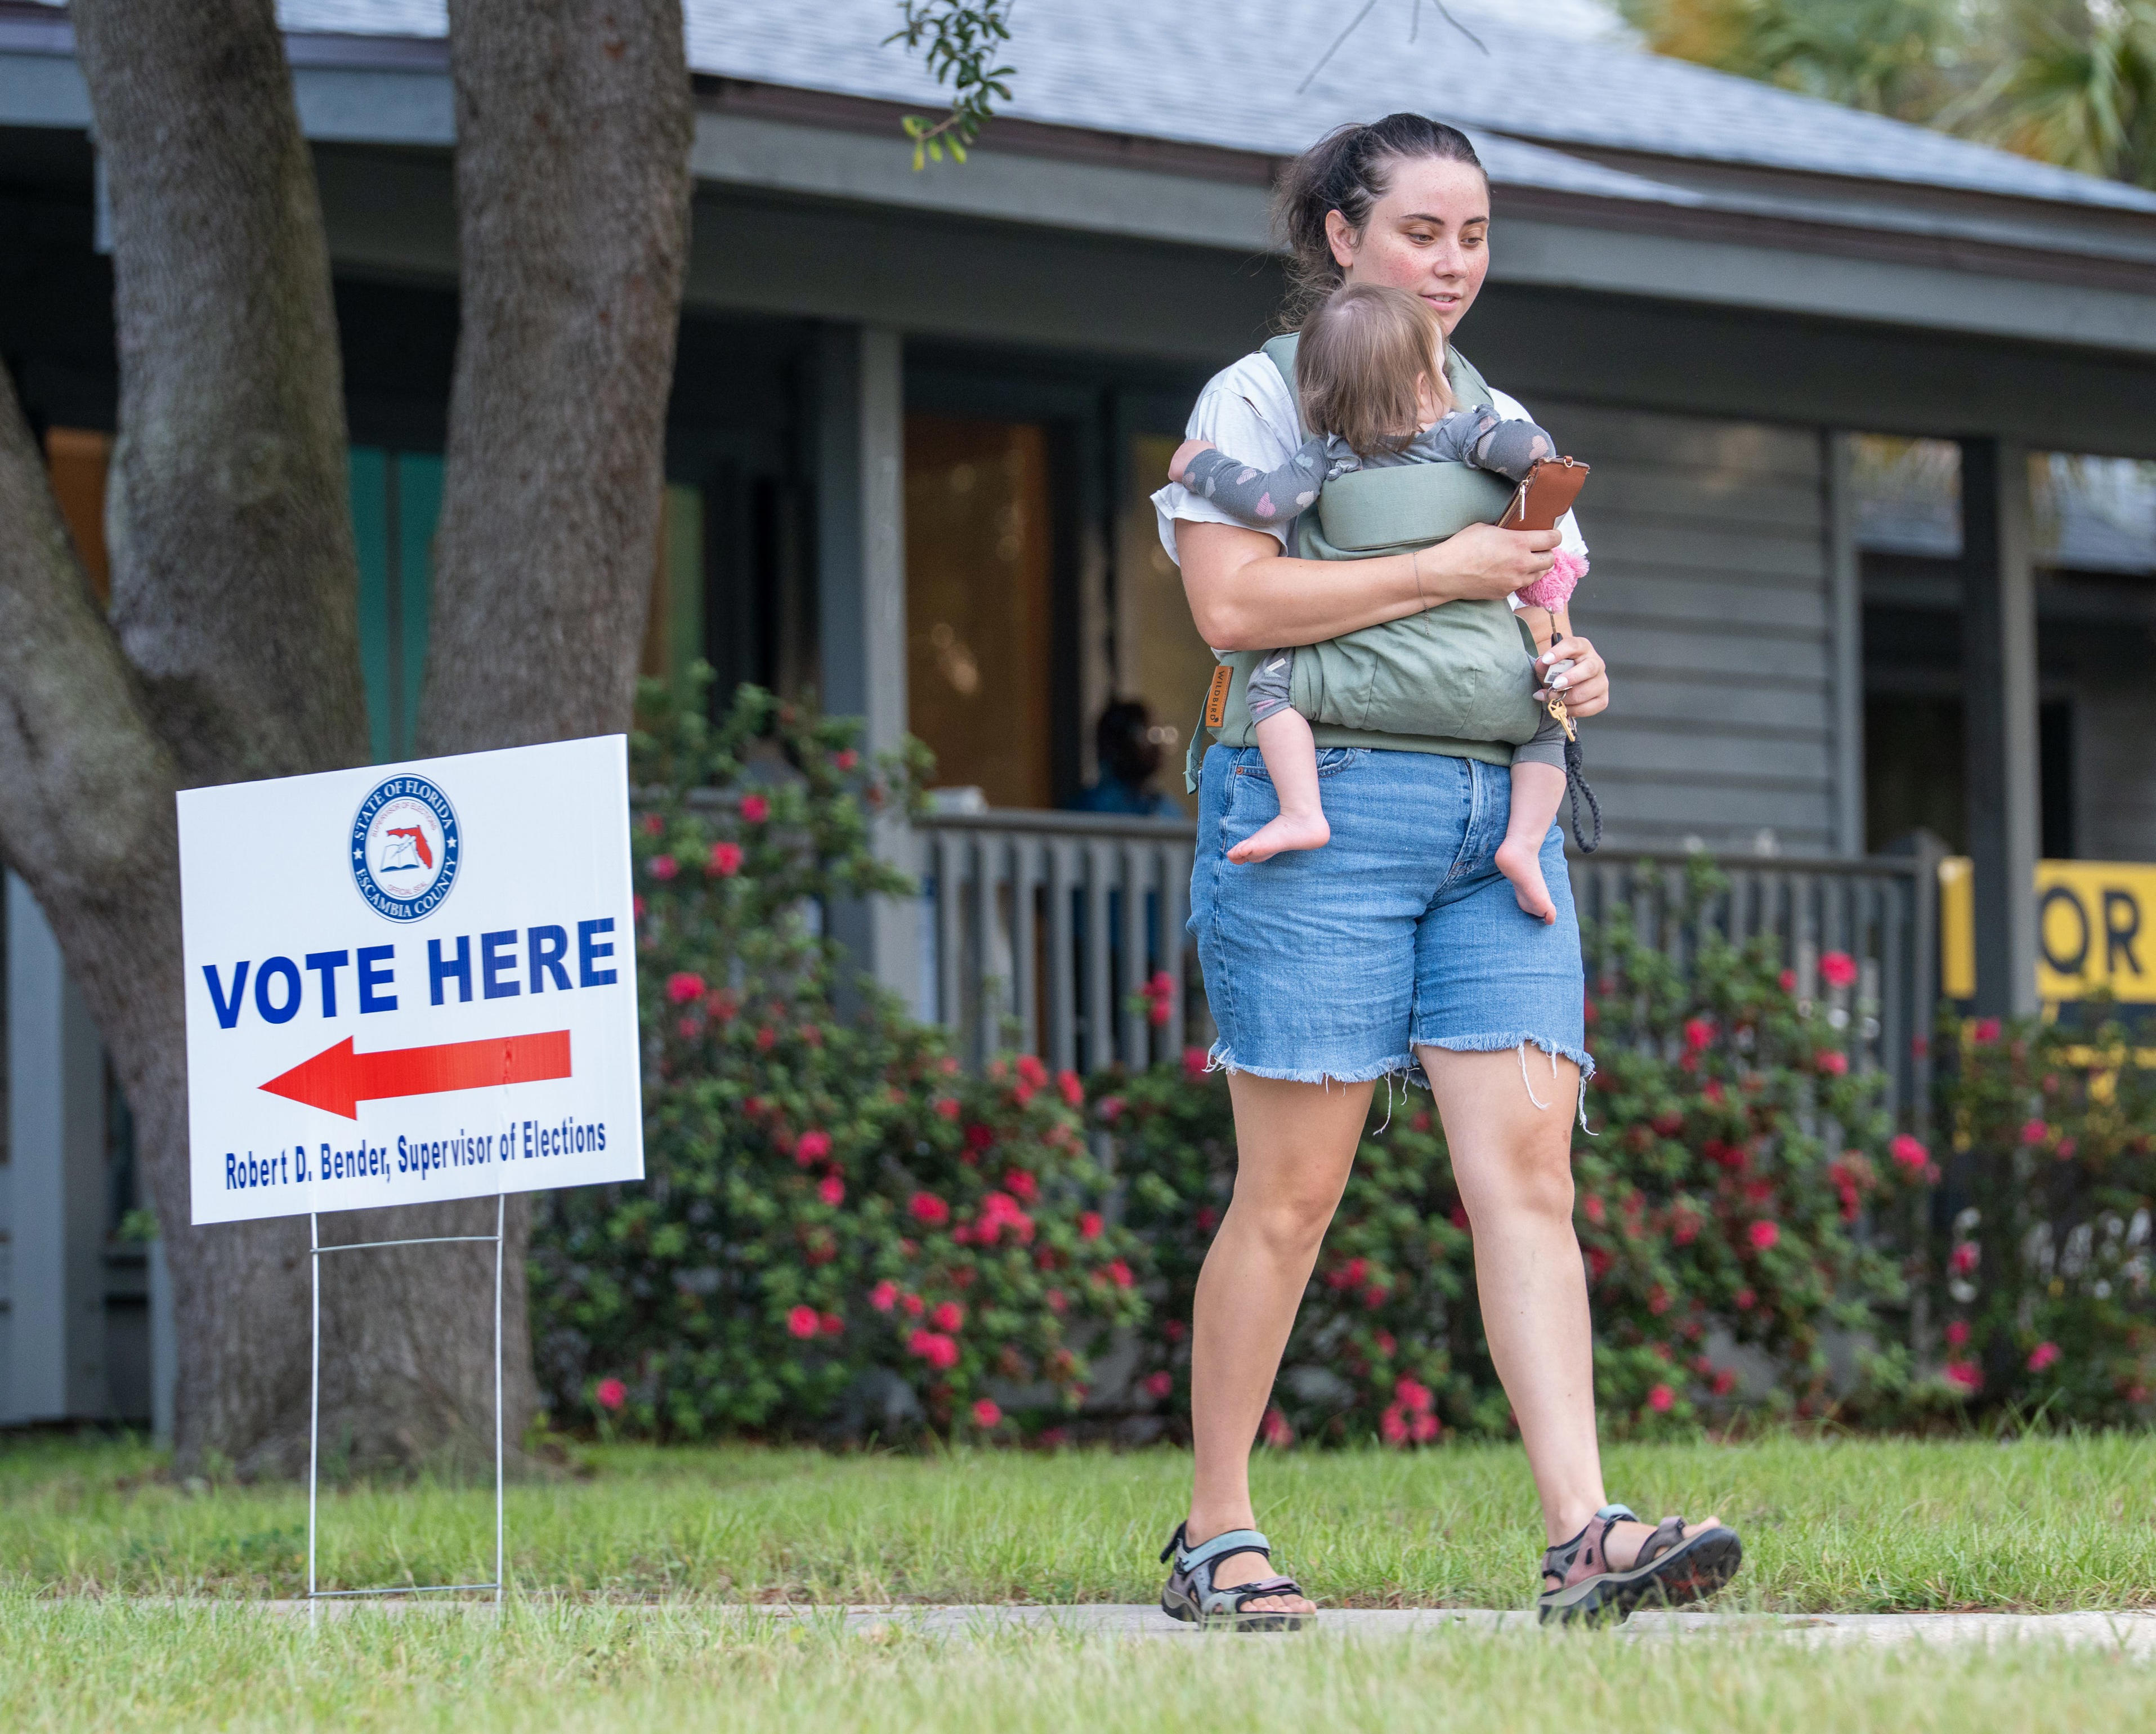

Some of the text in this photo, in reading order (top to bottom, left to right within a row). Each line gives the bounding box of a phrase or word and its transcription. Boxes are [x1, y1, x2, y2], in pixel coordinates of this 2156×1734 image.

[1210, 671, 1224, 722] WILDBIRD
[354, 780, 454, 841] STATE OF FLORIDA
[356, 856, 456, 917] ESCAMBIA COUNTY
[202, 917, 618, 1029] VOTE HERE
[226, 1116, 606, 1190] Robert D. Bender, Supervisor of Elections
